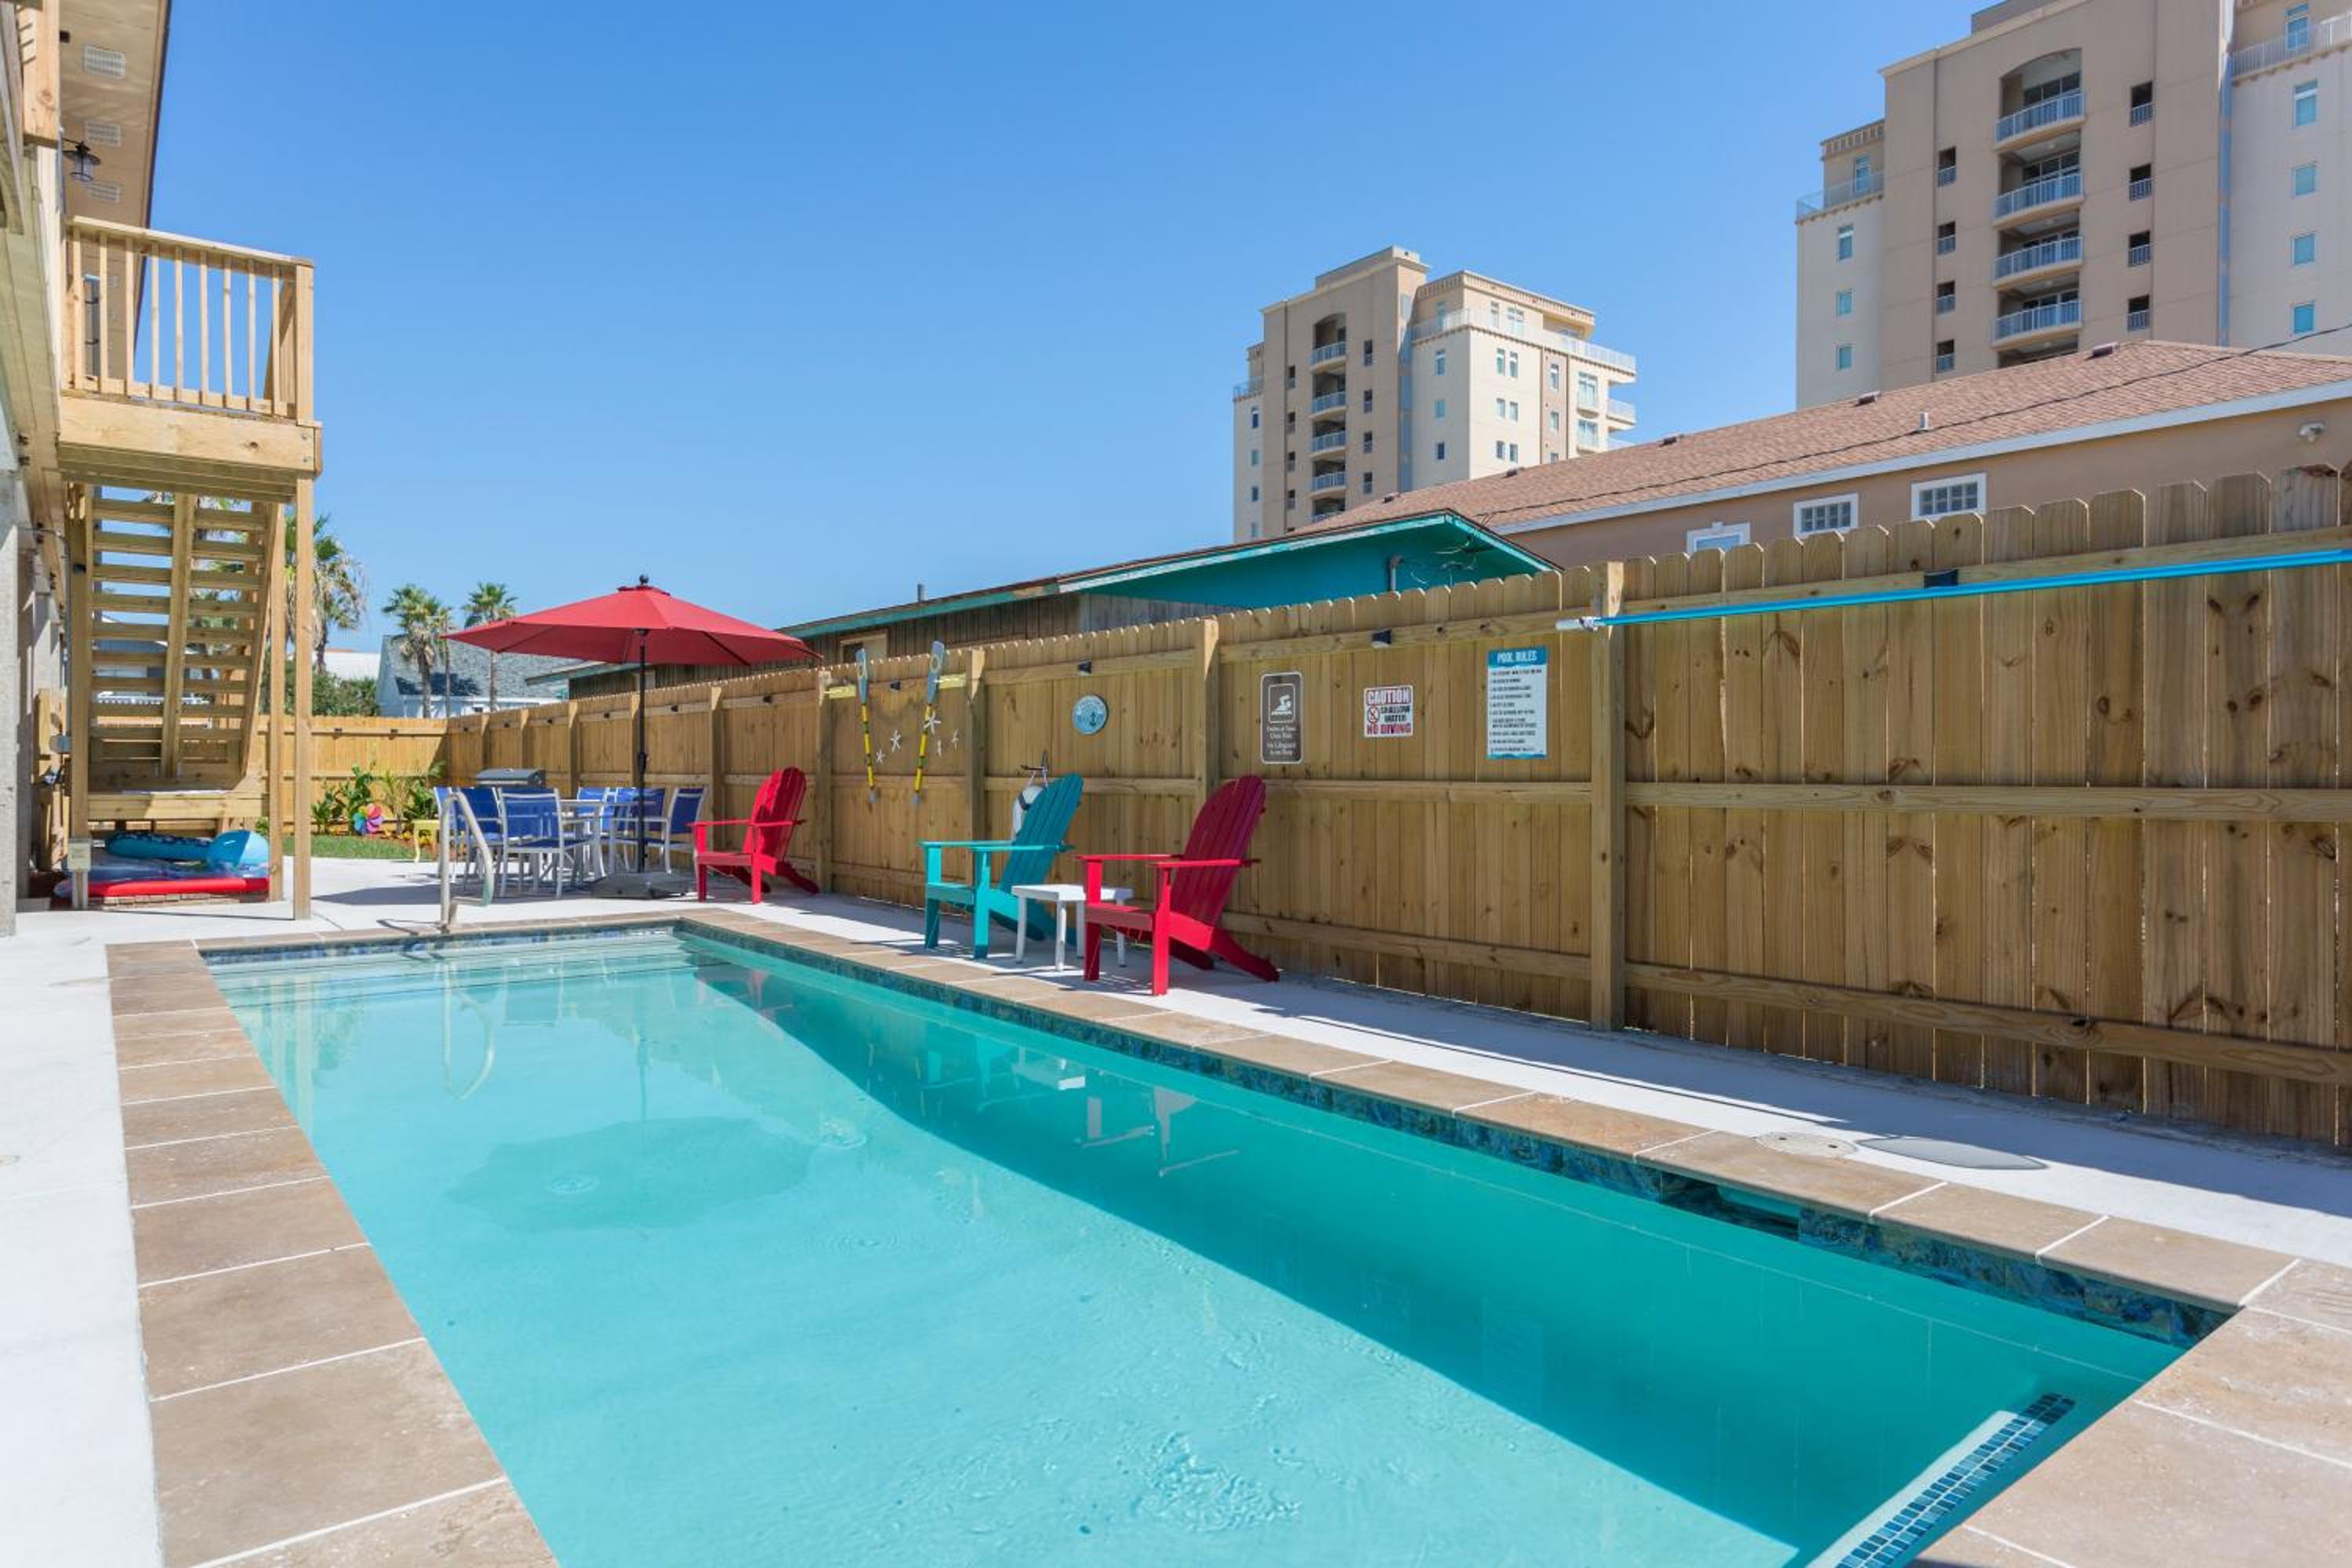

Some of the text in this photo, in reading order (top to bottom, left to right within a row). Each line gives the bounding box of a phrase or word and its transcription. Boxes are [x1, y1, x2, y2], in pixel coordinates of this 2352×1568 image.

[1368, 689, 1410, 704] CAUTION
[1367, 723, 1411, 735] NO DIVING
